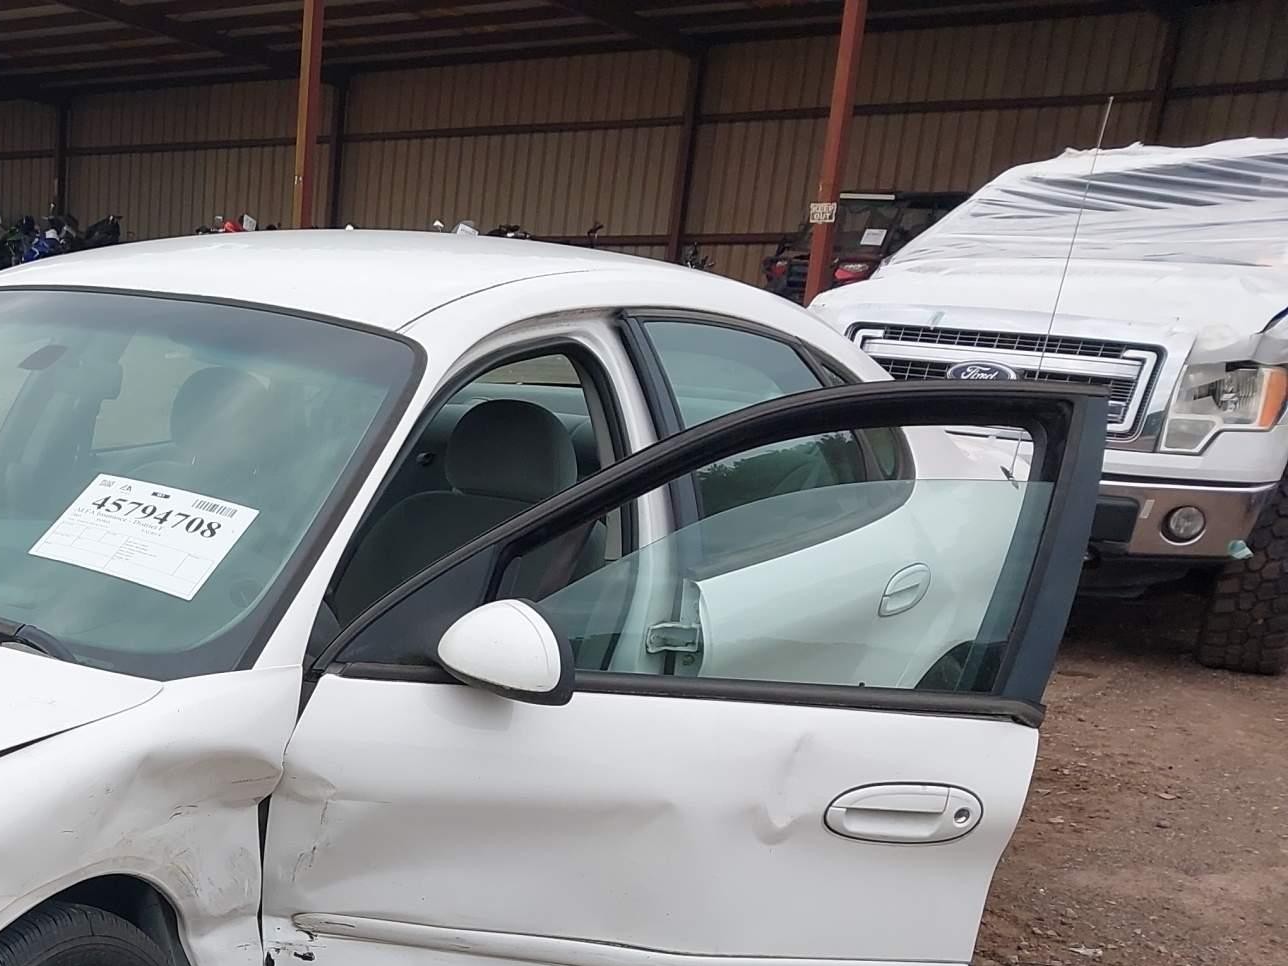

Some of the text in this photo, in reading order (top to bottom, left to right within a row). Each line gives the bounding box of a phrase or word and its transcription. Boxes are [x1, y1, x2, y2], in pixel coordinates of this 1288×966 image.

[814, 212, 831, 220] OUT
[961, 365, 999, 380] Ford
[91, 495, 222, 539] 45794708
